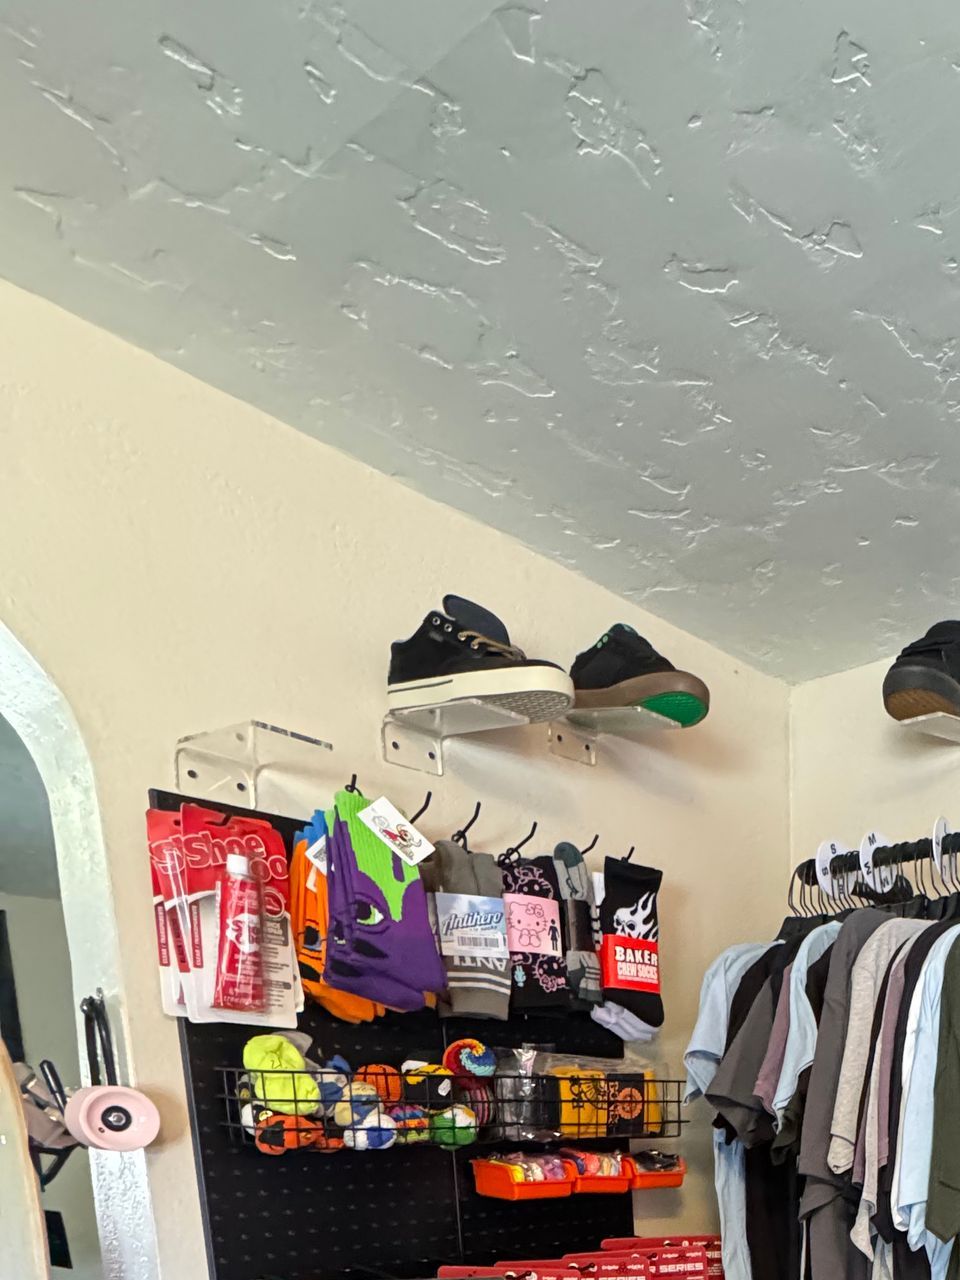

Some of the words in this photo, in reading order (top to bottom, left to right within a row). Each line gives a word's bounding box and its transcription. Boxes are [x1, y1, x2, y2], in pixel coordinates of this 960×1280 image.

[182, 831, 267, 869] Shoe
[868, 833, 877, 847] M
[442, 911, 504, 935] Antihero
[614, 945, 658, 966] BAKER
[660, 1262, 704, 1273] SERIES
